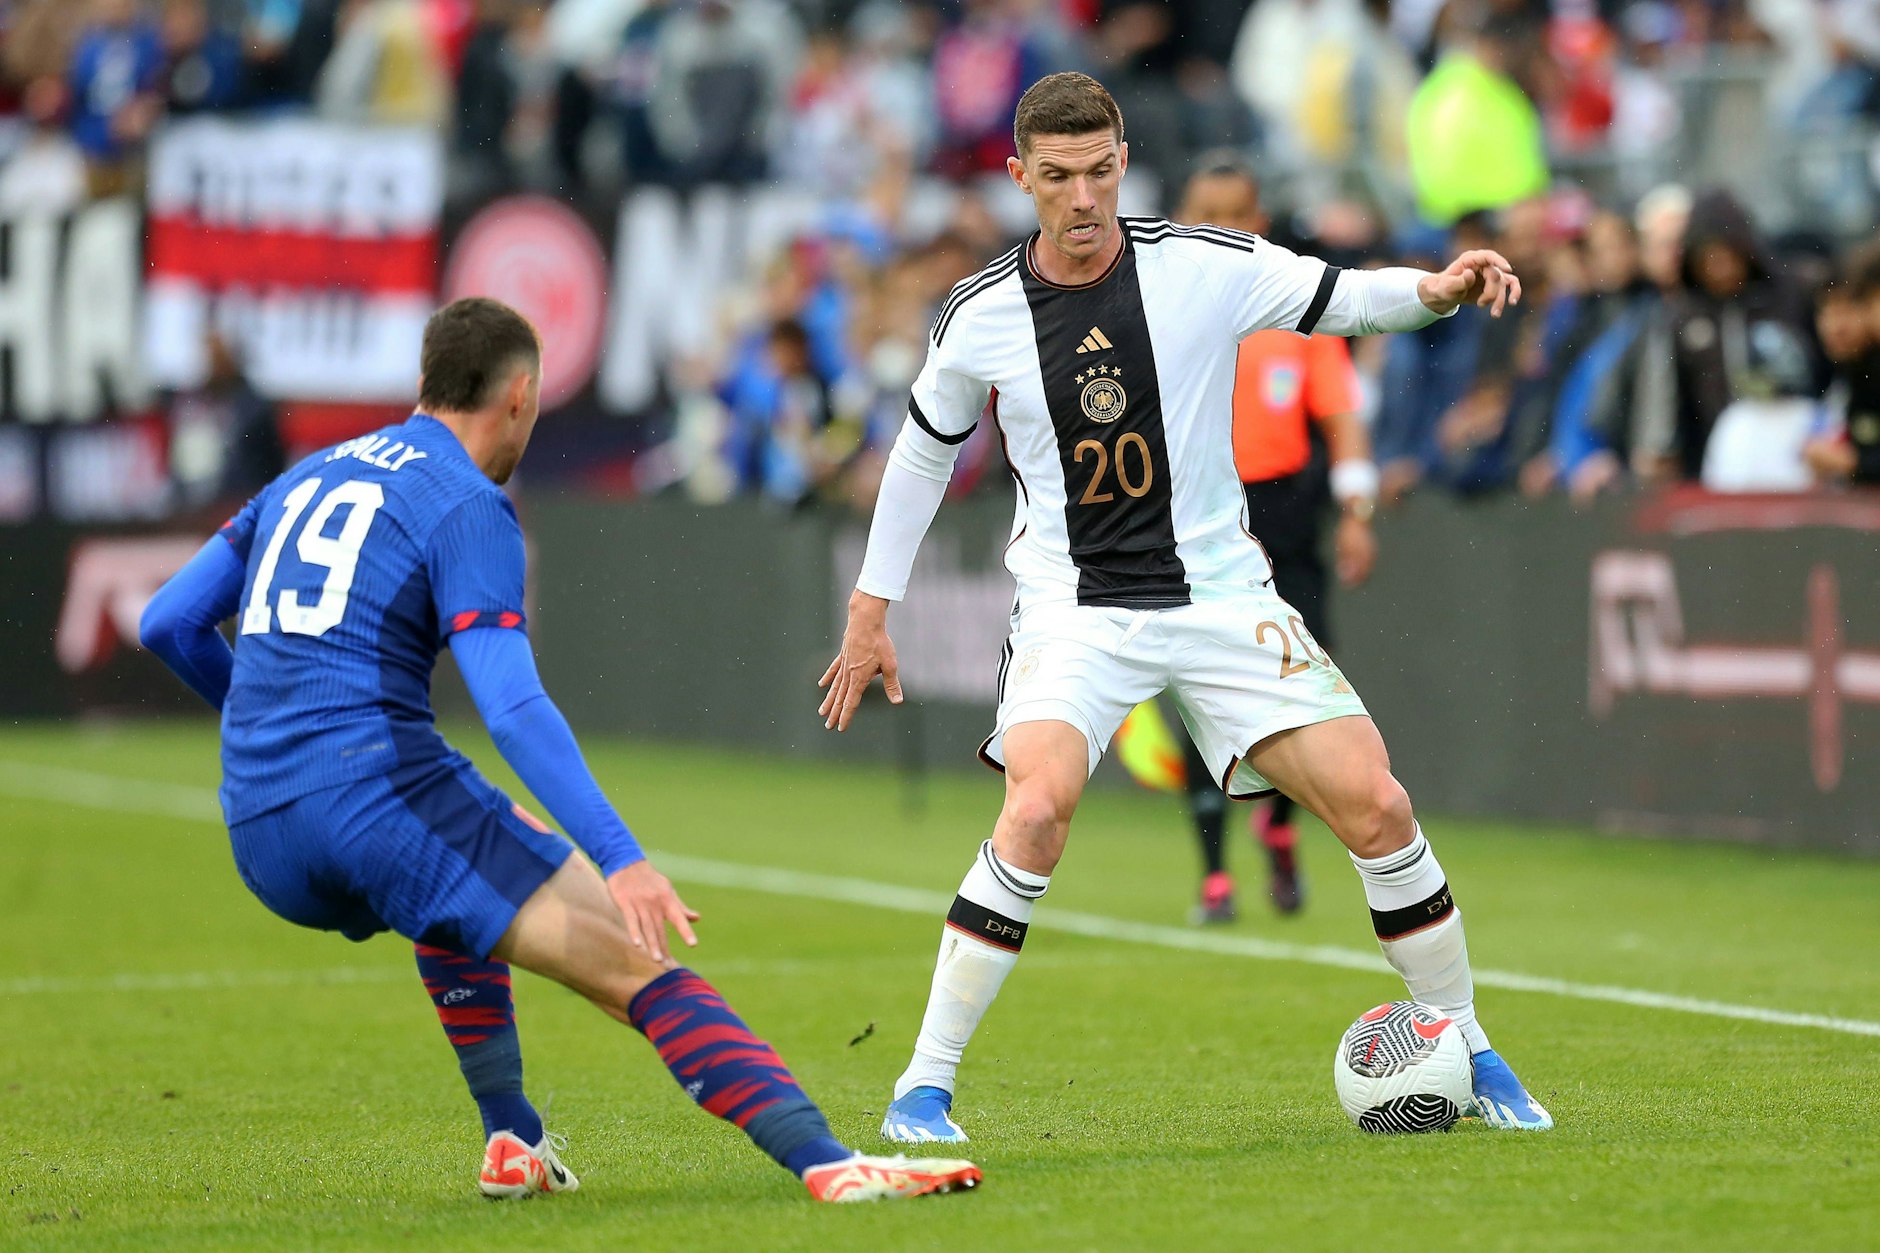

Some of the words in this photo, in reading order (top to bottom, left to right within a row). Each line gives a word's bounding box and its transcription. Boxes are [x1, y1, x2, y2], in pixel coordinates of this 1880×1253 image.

[1074, 432, 1153, 505] 20
[241, 477, 385, 637] 19
[1255, 615, 1330, 679] 20
[985, 919, 1021, 940] DFB
